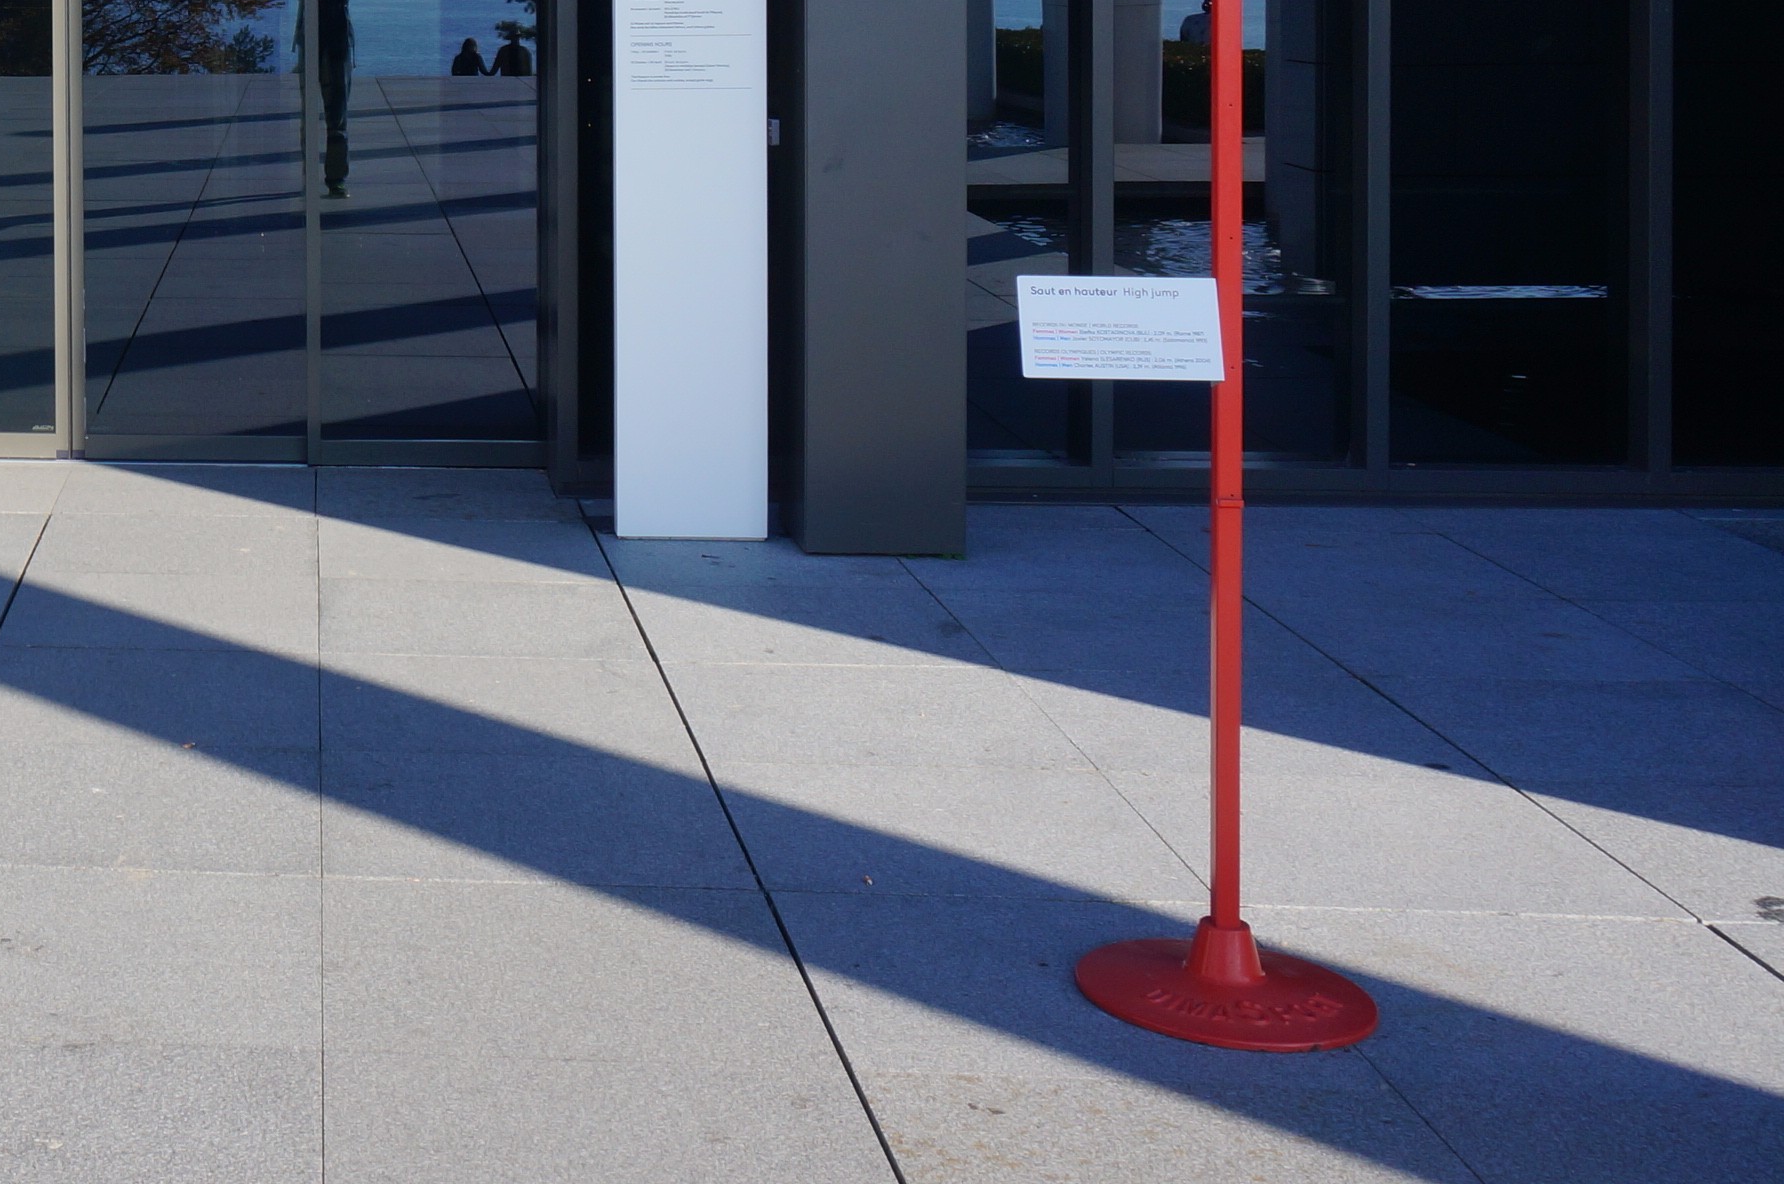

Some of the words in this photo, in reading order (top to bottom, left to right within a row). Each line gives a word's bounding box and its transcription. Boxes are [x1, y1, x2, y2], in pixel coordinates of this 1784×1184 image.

[1030, 286, 1055, 296] Saut
[1074, 286, 1118, 297] hauteur
[1123, 287, 1149, 300] High
[1151, 287, 1179, 300] jump
